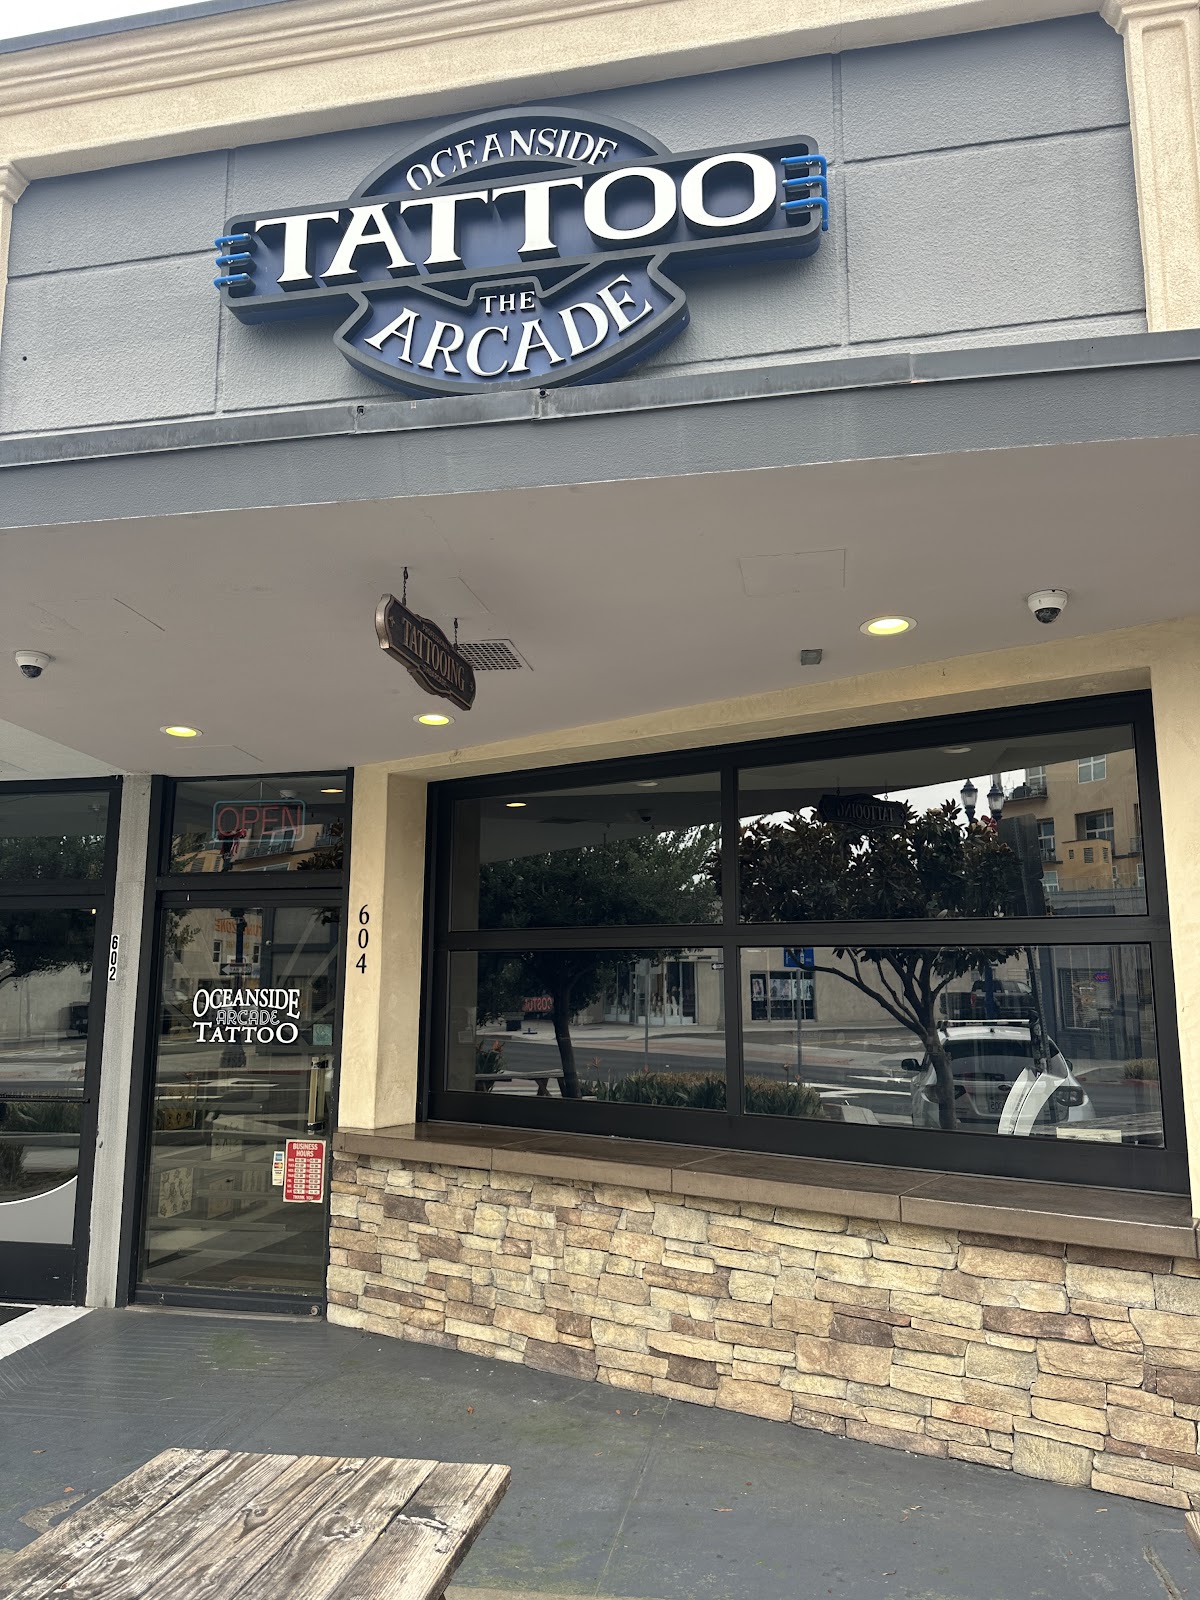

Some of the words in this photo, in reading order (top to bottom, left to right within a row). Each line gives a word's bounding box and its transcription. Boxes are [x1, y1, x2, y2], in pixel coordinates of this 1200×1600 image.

[406, 128, 617, 191] OCEANSIDE
[255, 152, 777, 284] TATTOO
[480, 290, 535, 314] THE
[363, 274, 652, 378] ARCADE
[402, 618, 465, 692] TATTOOING
[217, 804, 302, 837] OPEN
[108, 935, 119, 981] 602
[356, 904, 370, 974] 604
[193, 988, 300, 1019] OCEANSIDE
[216, 1009, 280, 1025] ARCADE
[193, 1021, 299, 1044] TATTOO
